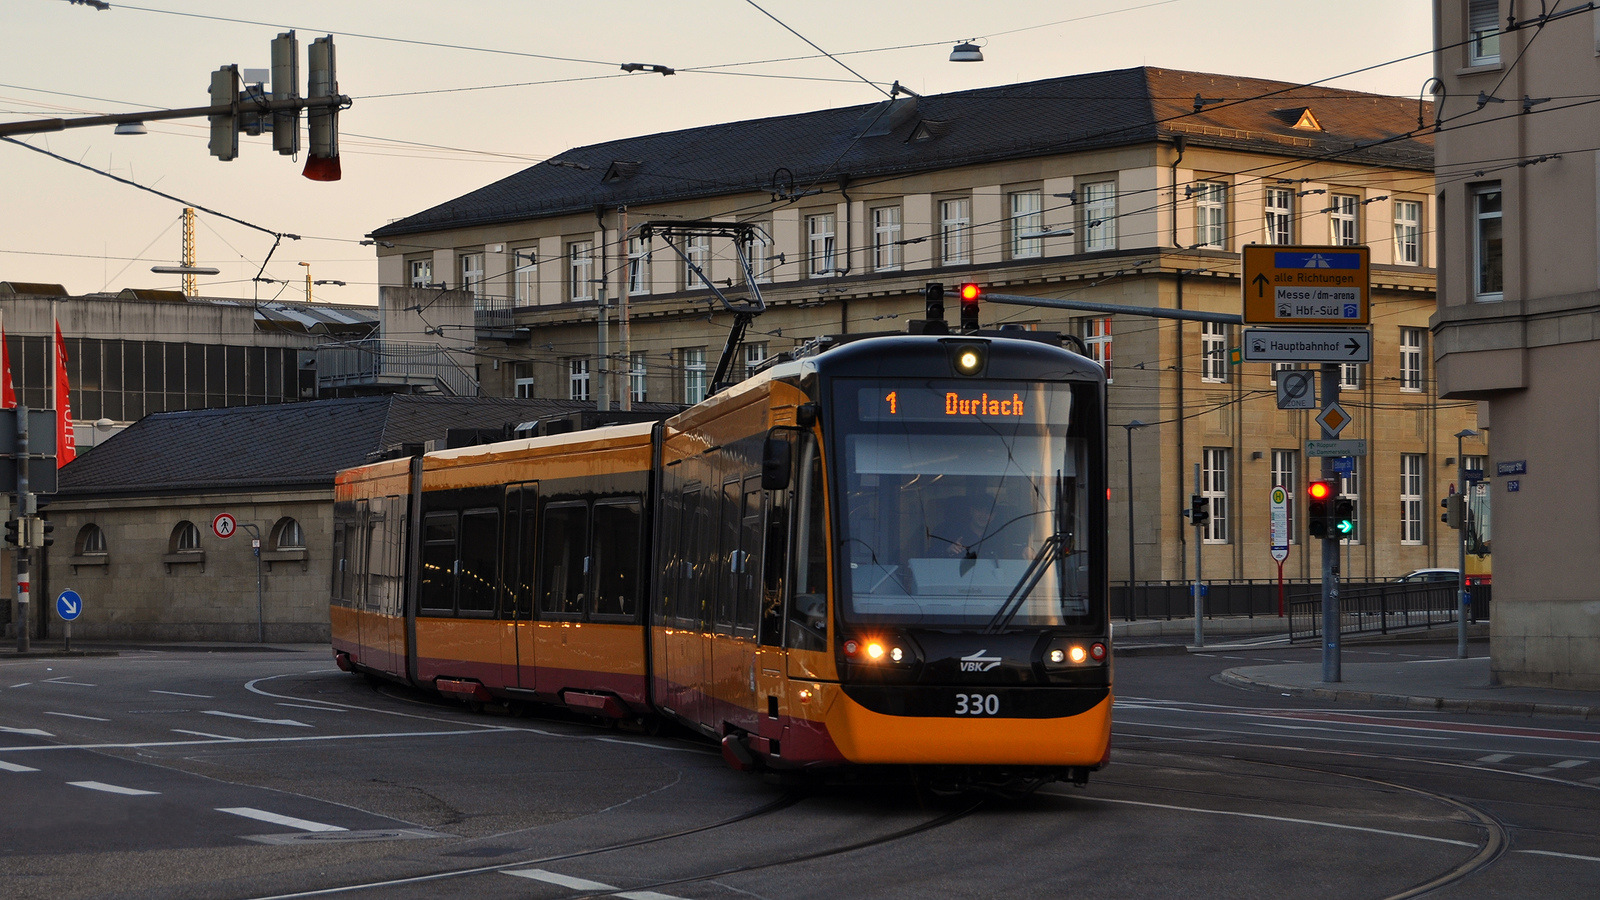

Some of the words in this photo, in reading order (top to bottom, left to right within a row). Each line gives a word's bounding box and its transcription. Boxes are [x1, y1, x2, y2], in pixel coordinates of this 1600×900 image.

[1274, 273, 1293, 282] alle
[1297, 273, 1354, 285] Richtungen
[1277, 289, 1310, 300] Messe
[1295, 305, 1339, 316] Hbf.-Süd
[1270, 340, 1340, 352] Hauptbahnhof
[885, 391, 897, 414] 1
[945, 392, 1024, 416] Durlach
[960, 661, 984, 672] VBK
[954, 693, 1000, 715] 330
